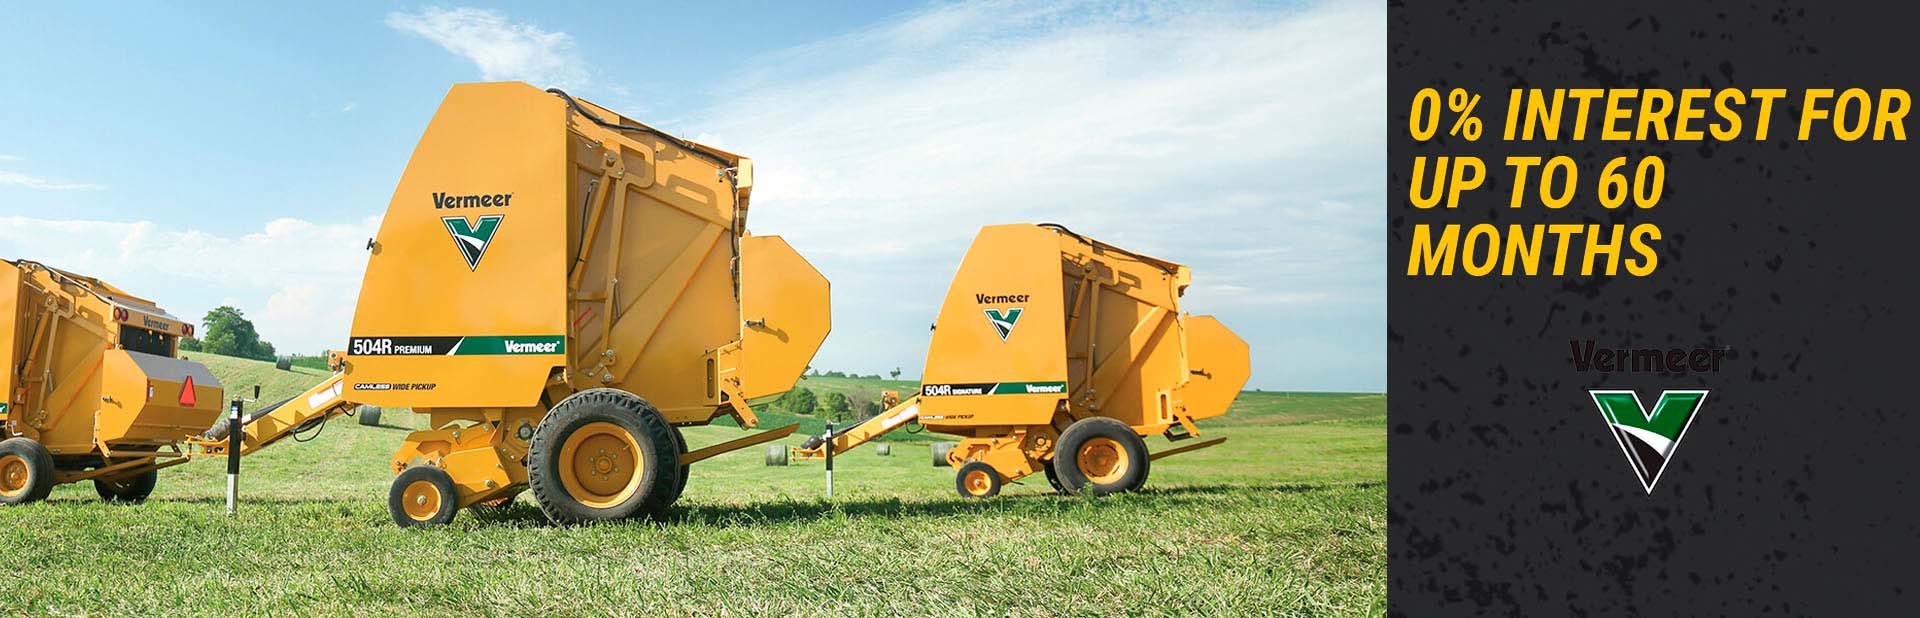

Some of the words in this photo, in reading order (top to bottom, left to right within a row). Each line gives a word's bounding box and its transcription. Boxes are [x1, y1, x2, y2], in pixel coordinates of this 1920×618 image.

[432, 192, 512, 209] Vermeer
[976, 293, 1030, 304] Vermeer
[353, 338, 393, 355] 504R
[394, 345, 433, 354] PREMIUM
[504, 340, 557, 353] Vermeer
[392, 383, 409, 391] WIDE
[410, 383, 437, 391] PICKUP
[925, 385, 952, 396] 504R
[1026, 384, 1062, 393] Vermeer
